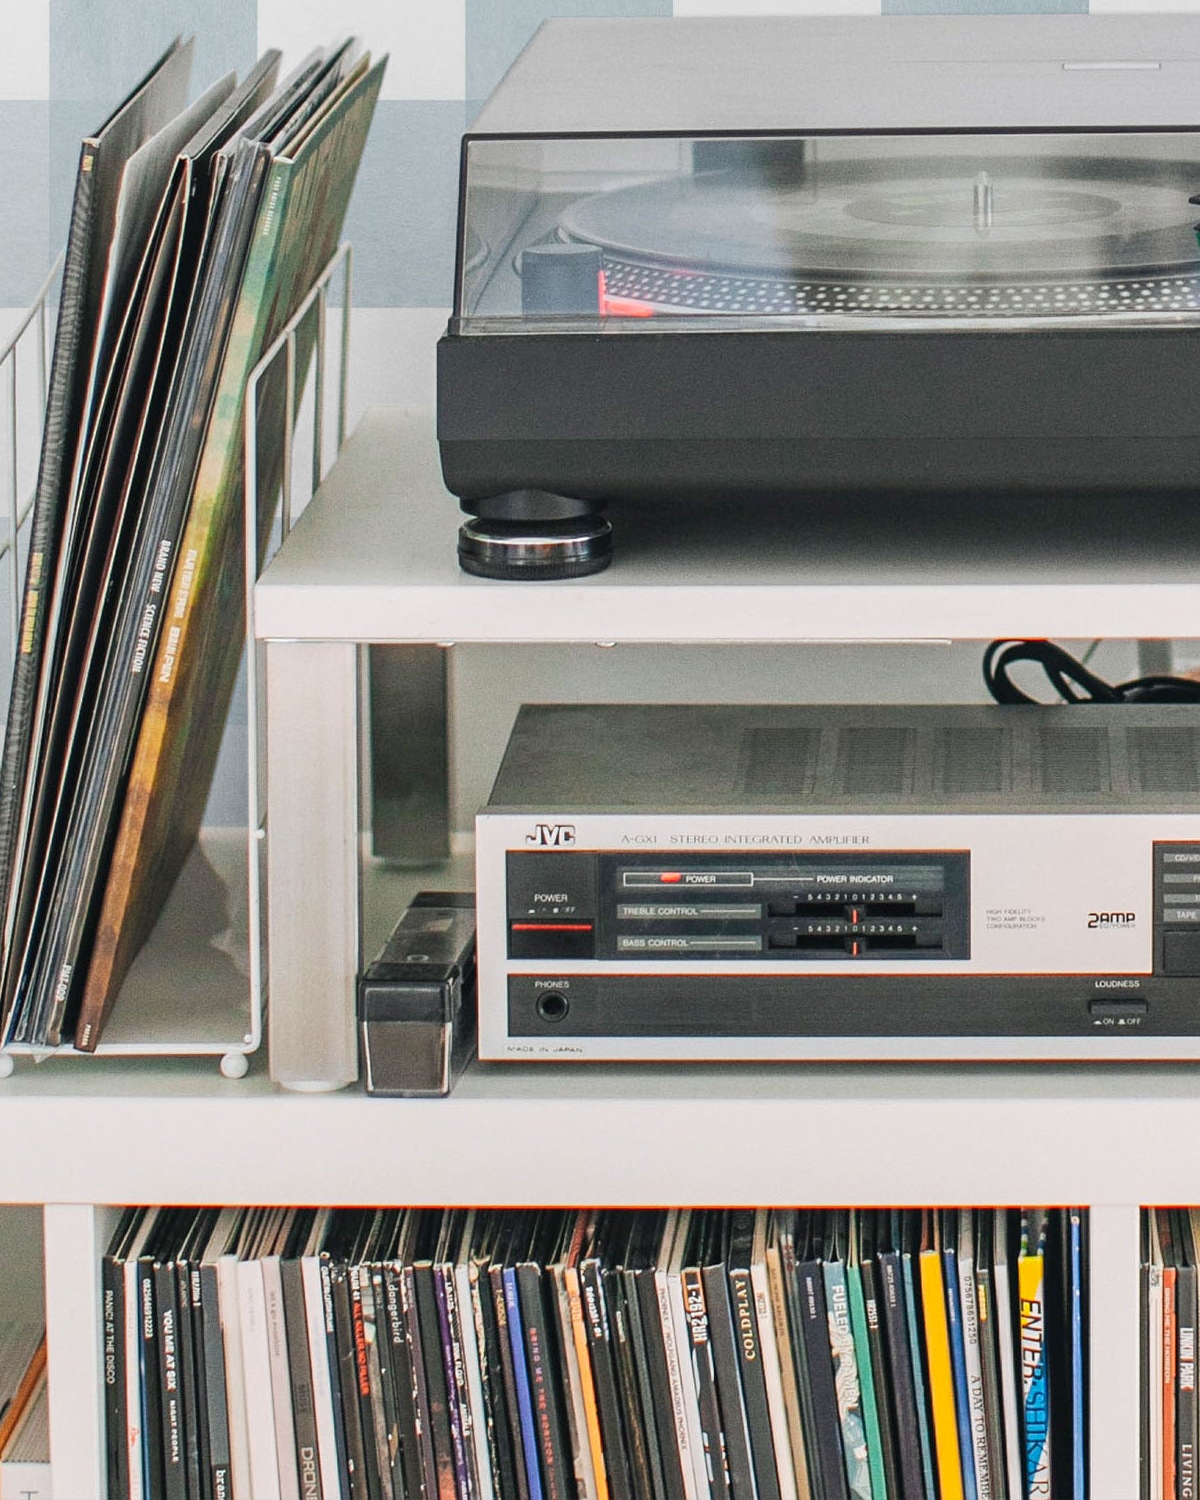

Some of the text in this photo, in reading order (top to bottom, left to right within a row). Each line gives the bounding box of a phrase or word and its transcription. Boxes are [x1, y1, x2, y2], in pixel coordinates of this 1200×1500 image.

[132, 539, 171, 673] BRAND NEW SCIENCE FICTION
[526, 824, 575, 845] JVC
[621, 834, 870, 844] A-GX1 STEREO INTEGRATED AMPLIFIER
[685, 875, 716, 884] POWER
[816, 875, 894, 884] POWER INDICATOR
[534, 893, 568, 903] POWER
[622, 907, 699, 916] TREBLE CONTROL
[1176, 911, 1198, 919] TAPE
[622, 938, 689, 947] BASS CONTROL
[535, 981, 570, 989] PHONES
[1095, 980, 1140, 988] LOUDNESS
[507, 1045, 583, 1053] MADE IN JAPAN
[387, 1284, 404, 1344] dangerbird
[659, 1288, 671, 1322] PHOENIX
[831, 1285, 849, 1335] FUELED
[735, 1279, 756, 1361] COLDPLAY
[105, 1290, 116, 1384] PANIC! AT THE DISCO
[529, 1327, 540, 1363] BRING
[1163, 1287, 1171, 1384] BRING ME THE HORIZON
[163, 1309, 179, 1463] YOU ME AT SIX NIGHT PEOPLE
[535, 1367, 543, 1384] ME
[971, 1374, 981, 1384] A
[538, 1388, 547, 1411] THE
[972, 1388, 984, 1413] DAY
[975, 1415, 985, 1432] TO
[1180, 1327, 1195, 1498] LINKIN PARK LIVING
[540, 1413, 554, 1465] HORIZON
[215, 1469, 226, 1500] bran
